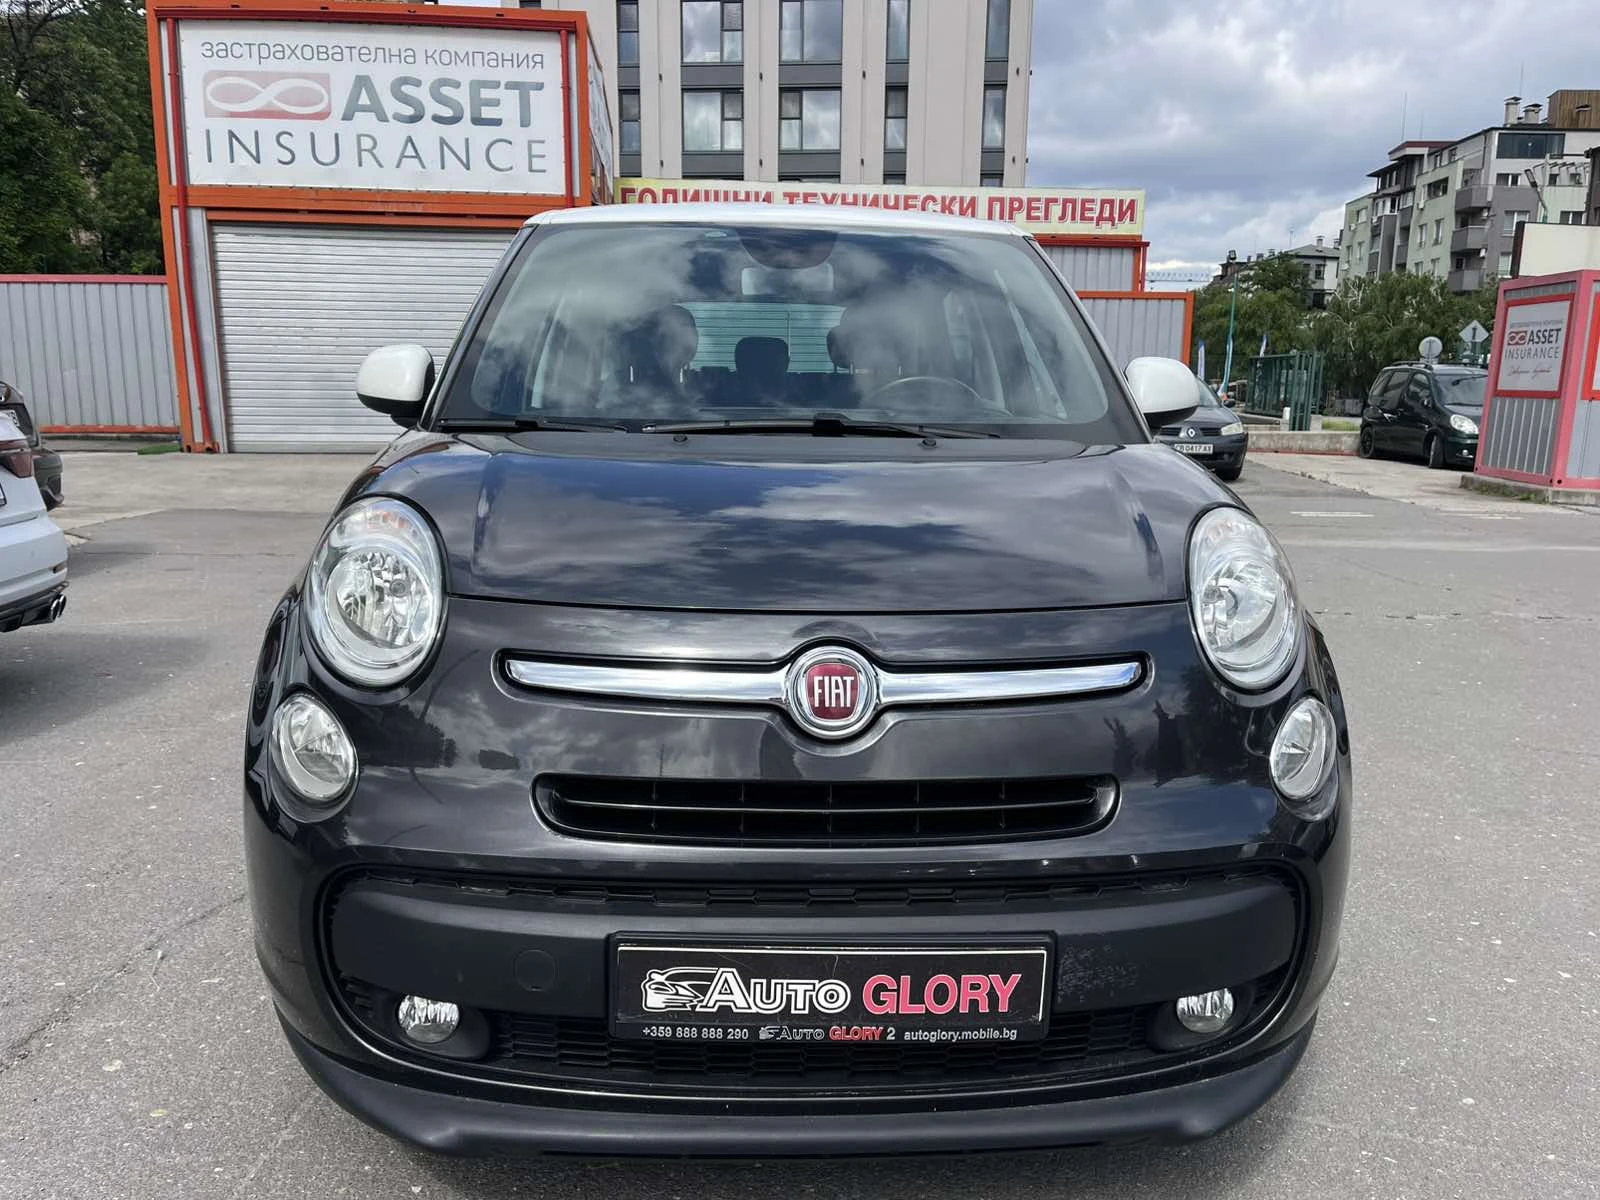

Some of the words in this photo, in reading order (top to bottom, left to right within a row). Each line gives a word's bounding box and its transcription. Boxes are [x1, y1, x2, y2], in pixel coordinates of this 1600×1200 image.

[200, 41, 417, 66] застрахователна
[424, 46, 545, 70] компания
[341, 74, 545, 128] ASSET
[204, 128, 548, 173] INSURANCE
[986, 196, 1138, 229] ПРЕГЛЕДИ
[1527, 328, 1561, 345] ASSET
[1504, 346, 1560, 361] INSURANCE
[813, 675, 855, 708] FIAT
[696, 967, 852, 1015] AUTO
[862, 973, 1022, 1015] GLORY
[642, 1026, 672, 1038] +359
[675, 1027, 698, 1039] 888
[701, 1027, 724, 1040] 888
[727, 1028, 749, 1040] 290
[776, 1025, 826, 1041] AUTO
[828, 1025, 884, 1041] GLORY
[886, 1027, 896, 1041] 2
[903, 1027, 1018, 1042] autoglory.mobile.bg
